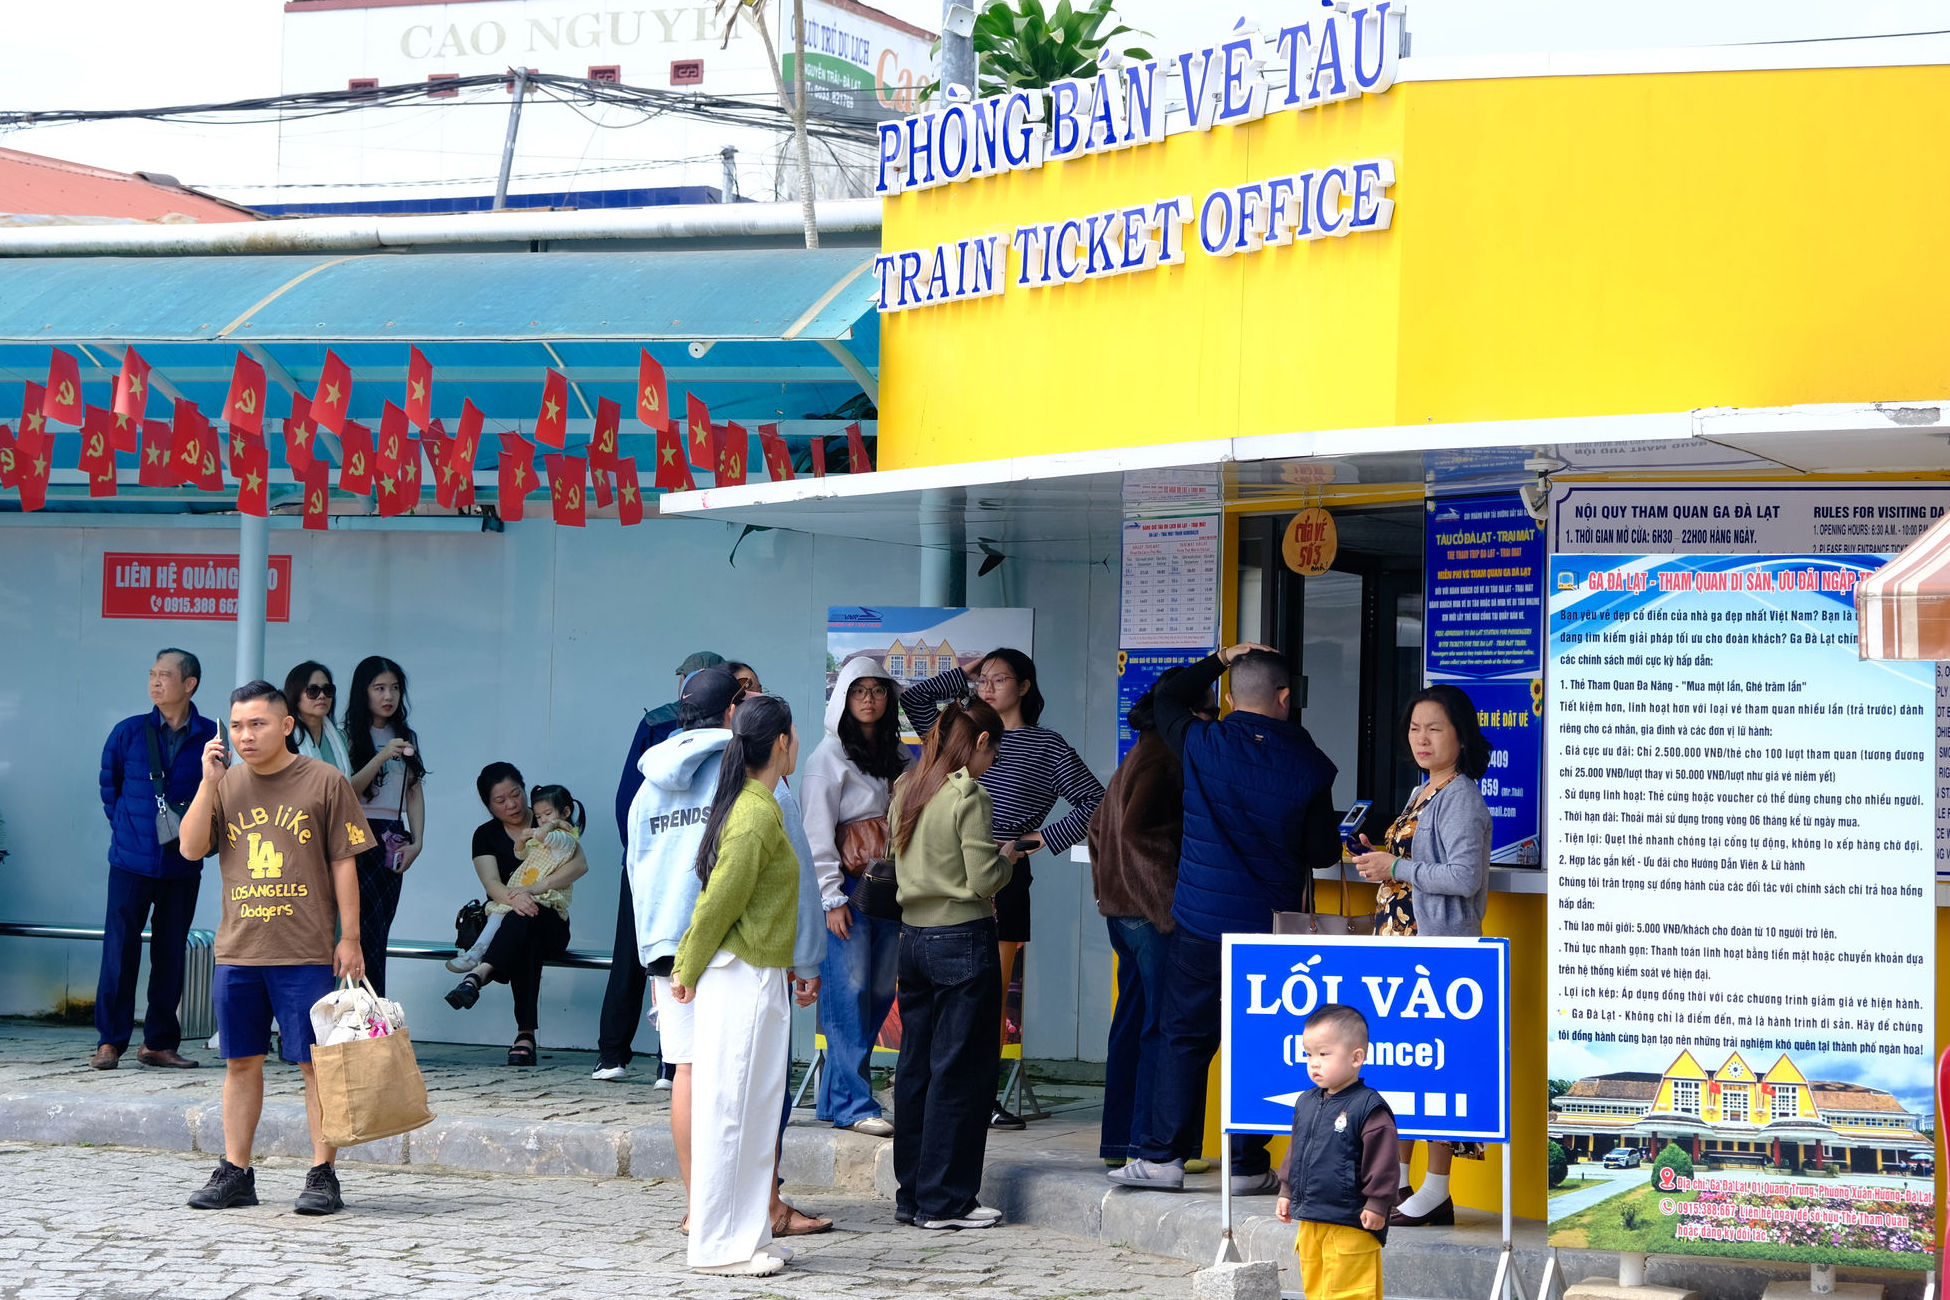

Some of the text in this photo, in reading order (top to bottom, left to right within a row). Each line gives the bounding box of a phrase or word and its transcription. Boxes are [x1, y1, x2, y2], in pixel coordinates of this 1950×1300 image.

[400, 20, 507, 60] CAO
[876, 48, 931, 113] Cao
[876, 0, 1390, 192] PHÒNG BÁN VÉ TÀU
[874, 162, 1381, 311] TRAIN TICKET OFFICE
[1575, 502, 1780, 522] NỘI QUY THAM QUAN GA ĐÀ LẠT
[1814, 506, 1944, 518] RULES FOR VISITING DA
[1566, 525, 1756, 544] 1. THỜI GIAN MỞ CỬA: 6H30 22H00 HÀNG NGÀY.
[1814, 525, 1818, 536] 1.
[1820, 525, 1846, 536] OPENING
[1848, 525, 1870, 536] HOURS:
[1872, 525, 1884, 536] 6:30
[1885, 525, 1898, 536] A.M.
[1902, 525, 1917, 536] 10:00
[116, 562, 151, 588] LIÊN
[156, 562, 178, 592] HỆ
[182, 560, 240, 590] QUẢNG
[1588, 572, 1604, 590] GA
[1607, 568, 1624, 590] ĐÀ
[1626, 572, 1648, 594] LẠT
[1658, 572, 1692, 591] THAM
[1695, 572, 1727, 593] QUAN
[1730, 572, 1743, 591] DI
[1746, 566, 1775, 593] SẢN,
[1778, 571, 1795, 590] ƯU
[1798, 568, 1818, 590] ĐÃI
[1822, 565, 1856, 595] NGẬP
[1560, 608, 1852, 624] Bạn yêu vẻ đẹp cổ điển của nhà ga đẹp nhất Việt Nam? Bạn là
[1491, 709, 1500, 730] HỆ
[1502, 710, 1517, 730] ĐẶT
[1519, 710, 1528, 727] VÉ
[1481, 778, 1498, 796] 659
[226, 807, 269, 849] MLB
[345, 822, 366, 846] LA
[247, 832, 284, 879] LA
[240, 903, 294, 922] Dodgers
[1246, 954, 1484, 1020] LỐI VÀO
[1558, 1029, 1924, 1055] tôi đồng hành cùng bạn tạo nên những trải nghiệm khó quên tại thành phố ngàn hoa!
[1678, 1202, 1736, 1216] 0915.388.667
